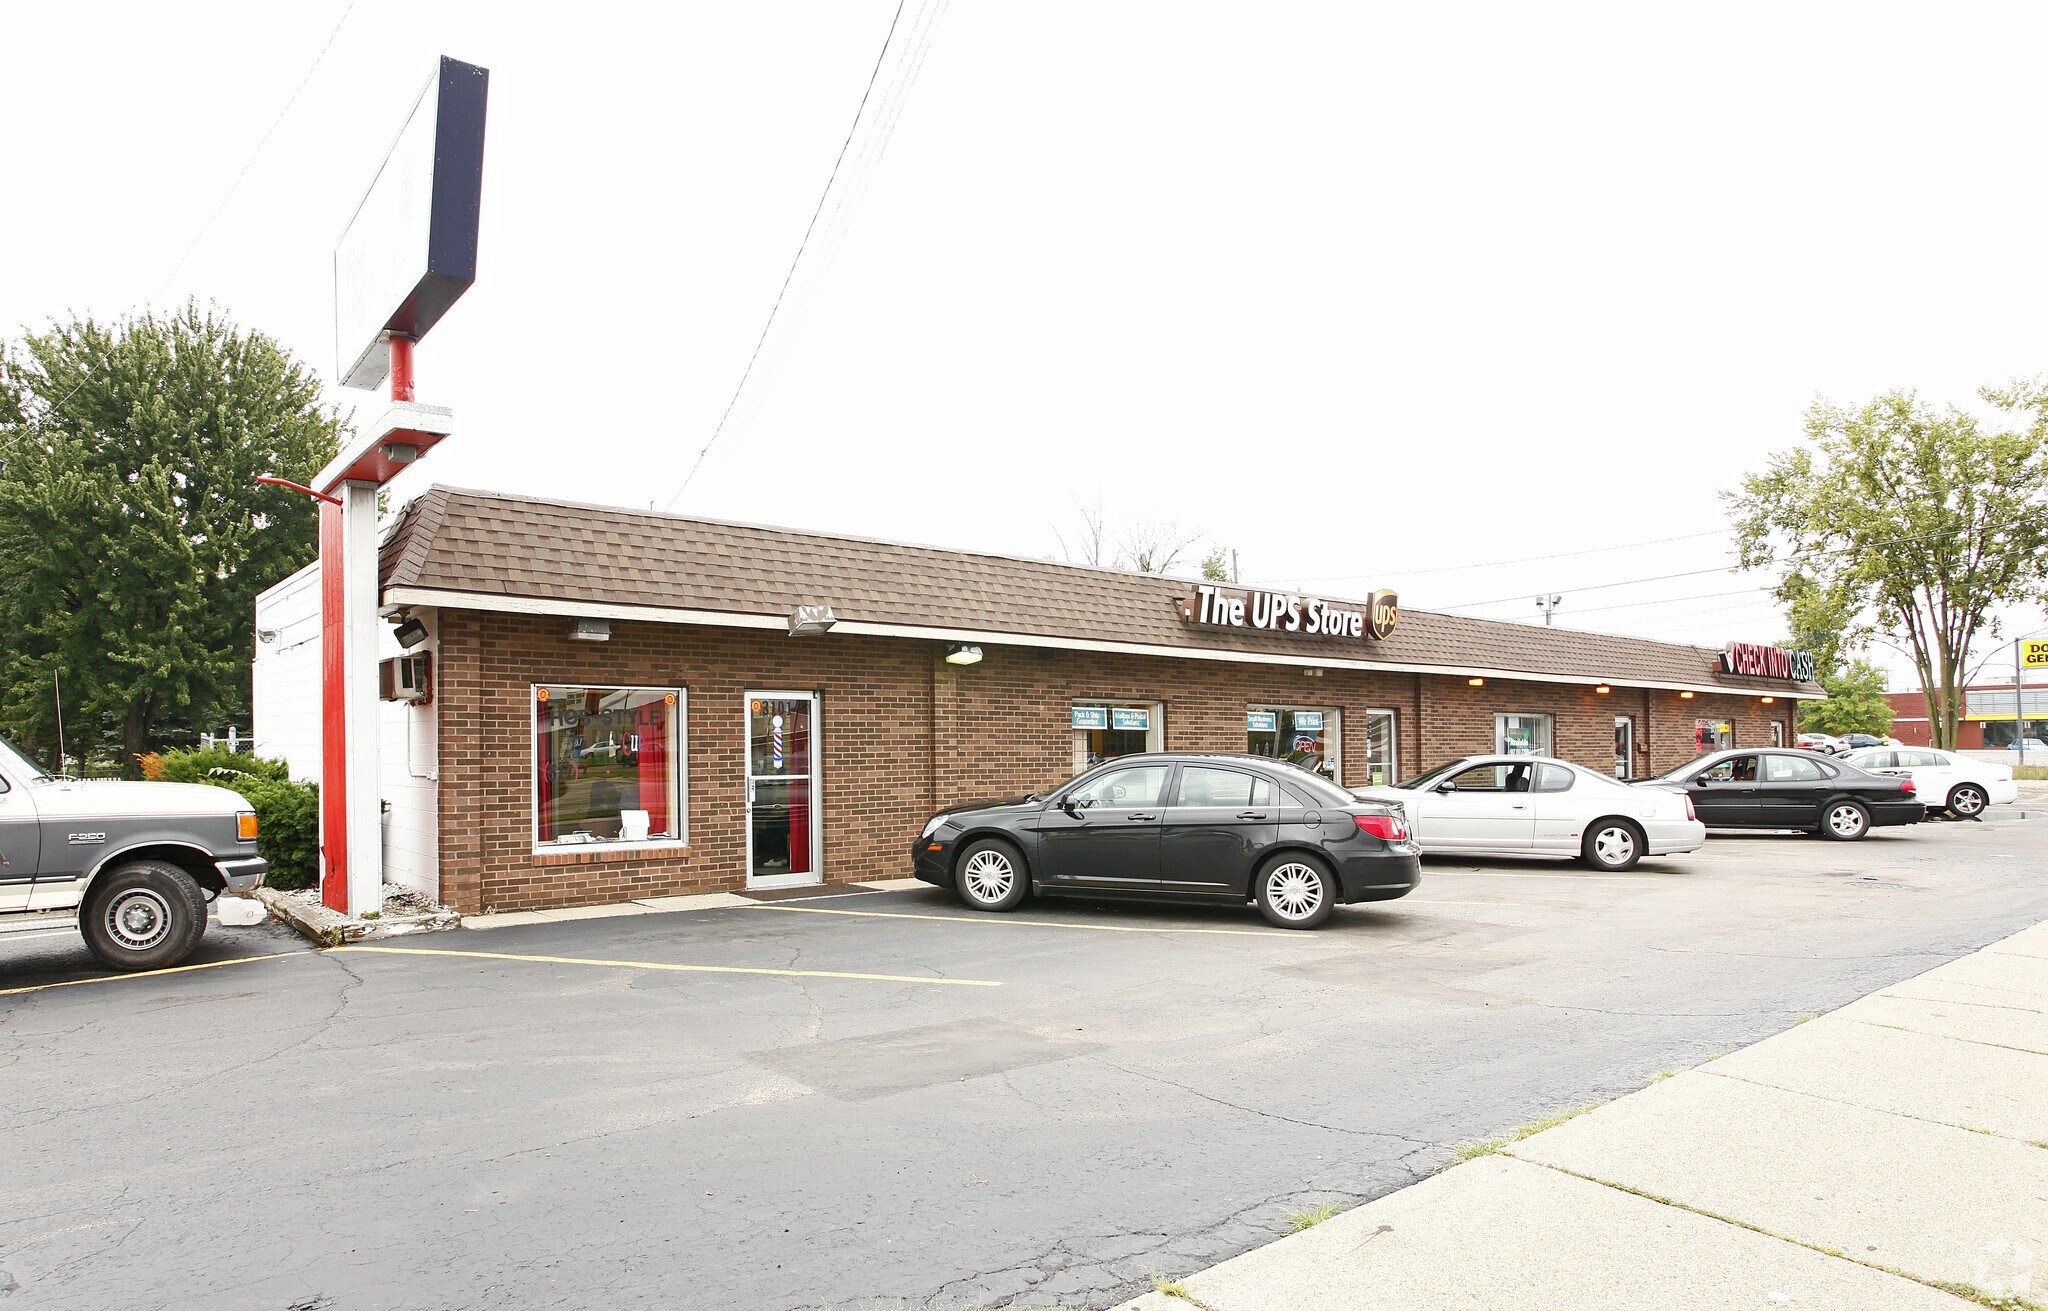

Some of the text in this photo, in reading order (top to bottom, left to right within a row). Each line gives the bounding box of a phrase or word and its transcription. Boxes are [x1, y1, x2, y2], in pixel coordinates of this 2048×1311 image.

[1199, 584, 1363, 637] The UPS Store
[1375, 604, 1397, 632] ups
[1736, 642, 1815, 680] CHECK INTO CASH
[762, 701, 792, 716] 3101
[1090, 711, 1100, 719] Ship
[601, 708, 662, 726] STYLE
[1298, 717, 1319, 726] We Print
[1296, 740, 1316, 752] OPEN
